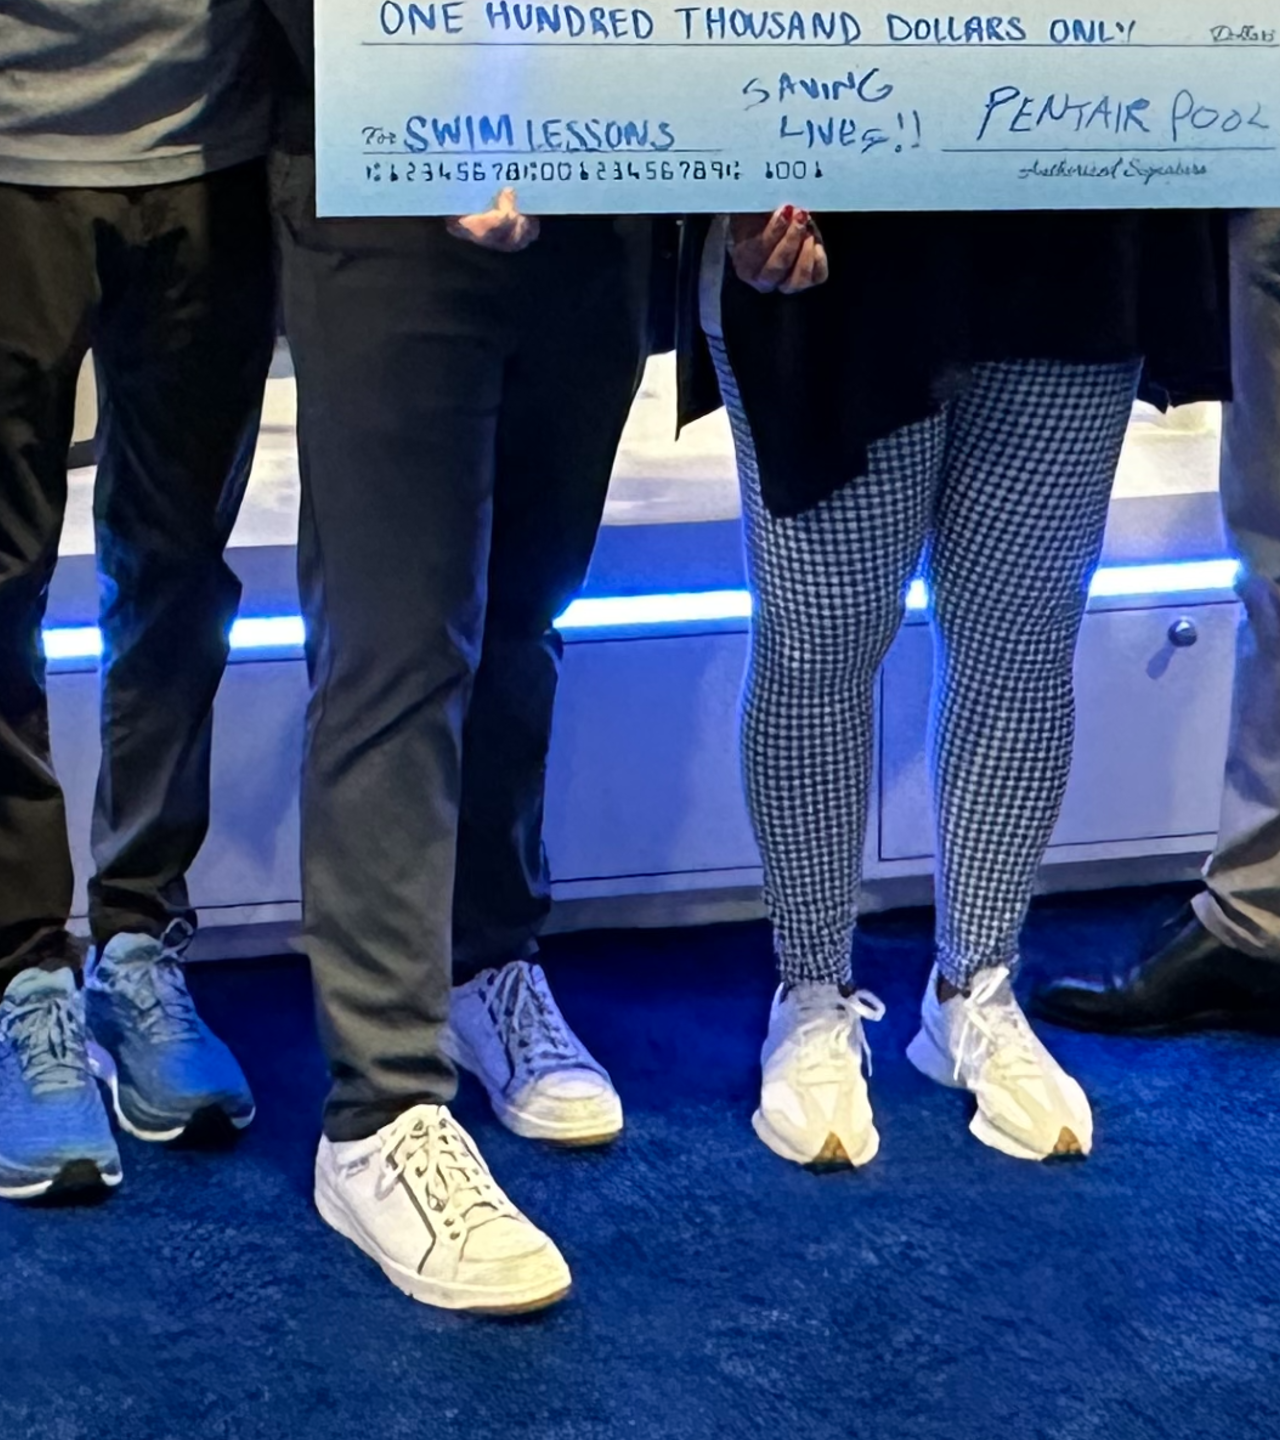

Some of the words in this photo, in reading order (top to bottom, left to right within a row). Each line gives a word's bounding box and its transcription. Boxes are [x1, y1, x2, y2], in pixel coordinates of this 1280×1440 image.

[380, 0, 466, 36] ONE
[485, 0, 654, 39] HUNDRED
[674, 6, 862, 43] THOUSAND
[885, 13, 1027, 43] DOLLARS
[1050, 18, 1137, 44] ONLY
[742, 68, 894, 111] SAVING
[404, 114, 515, 154] SWIM
[526, 119, 676, 152] LESSONS
[975, 85, 1152, 142] PENTAIR
[1171, 89, 1271, 142] POOL
